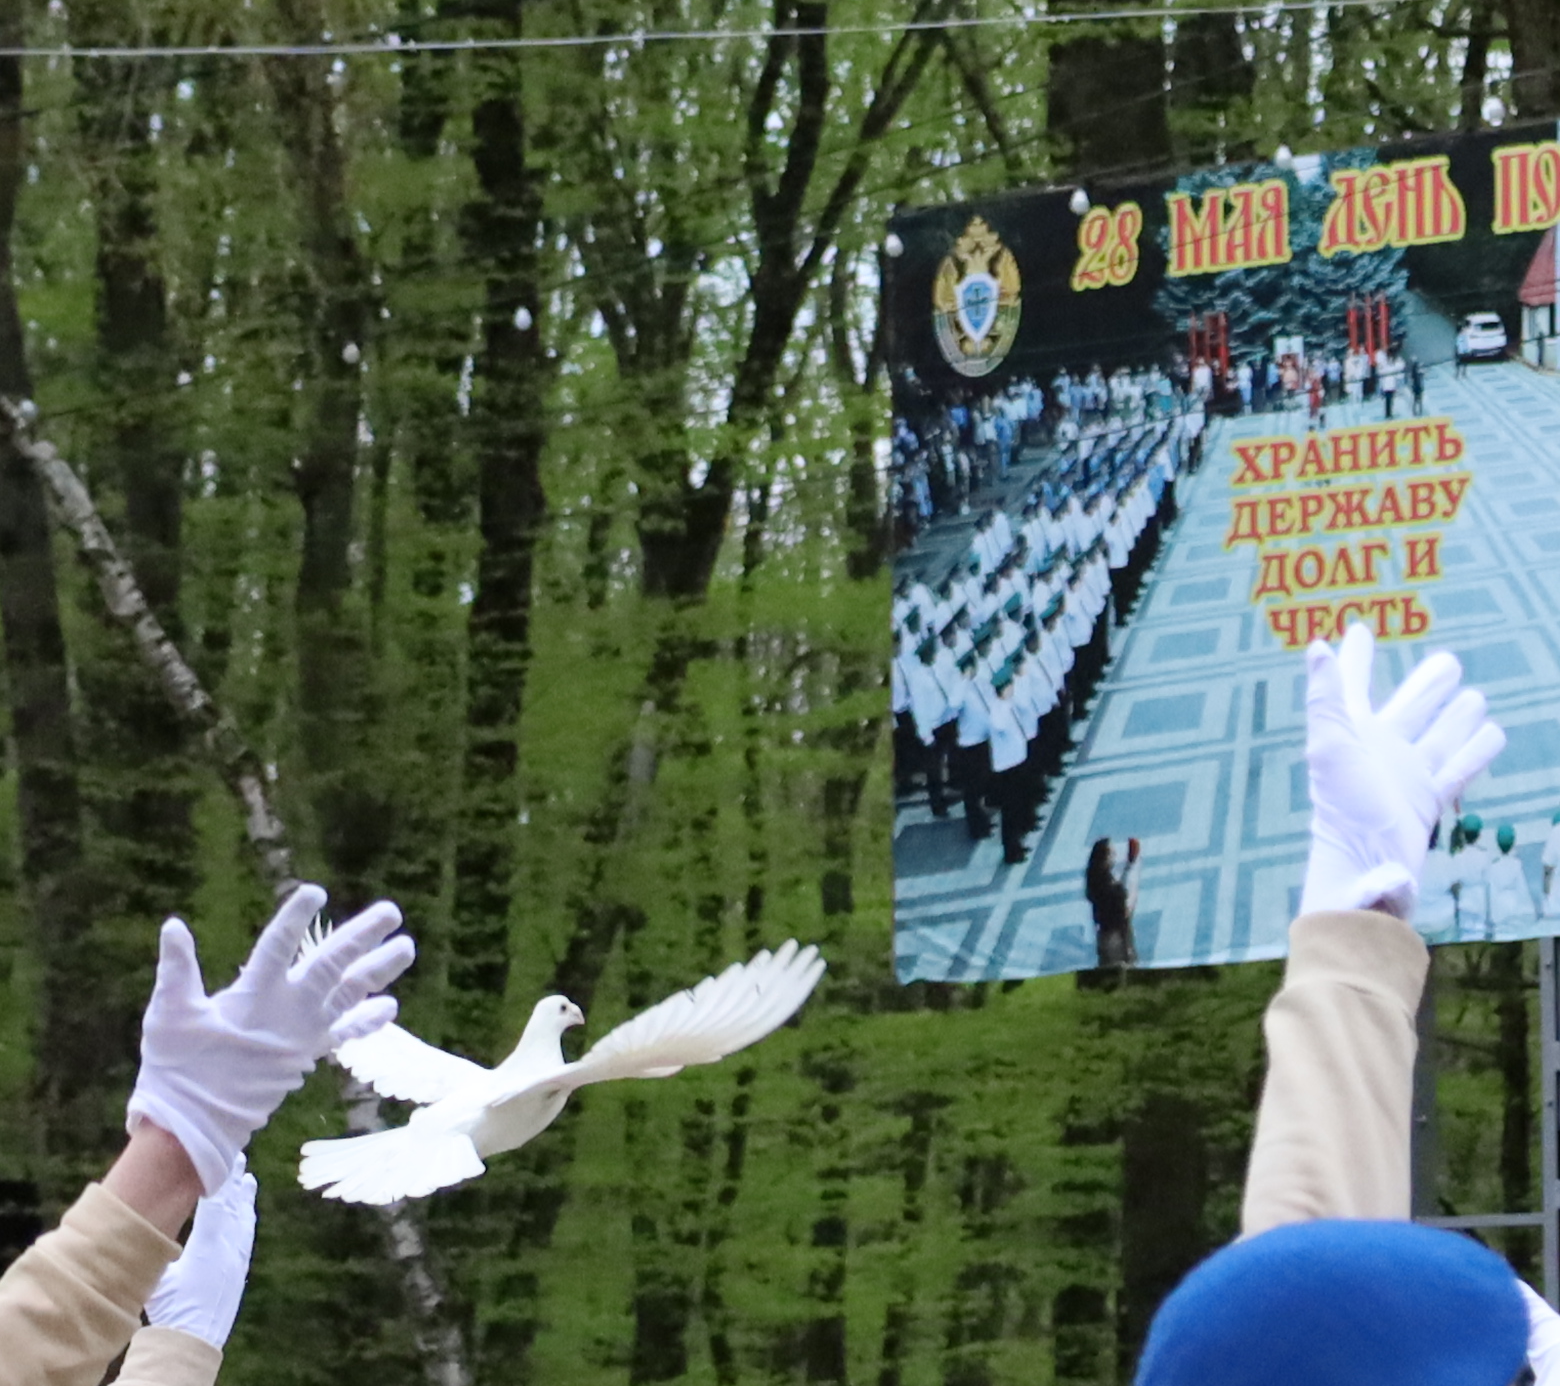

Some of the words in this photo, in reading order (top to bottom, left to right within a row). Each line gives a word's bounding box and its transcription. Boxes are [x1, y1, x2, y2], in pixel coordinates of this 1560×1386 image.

[1071, 202, 1142, 291] 28
[1165, 179, 1292, 277] МАЯ
[1318, 155, 1466, 258] ДЕНЬ
[1231, 419, 1464, 487] ХРАНИТЬ
[1226, 474, 1471, 551] ДЕРЖАВУ
[1252, 536, 1389, 603] ДОЛГ
[1404, 534, 1440, 581] И
[1268, 593, 1430, 649] ЧЕСТЬ
